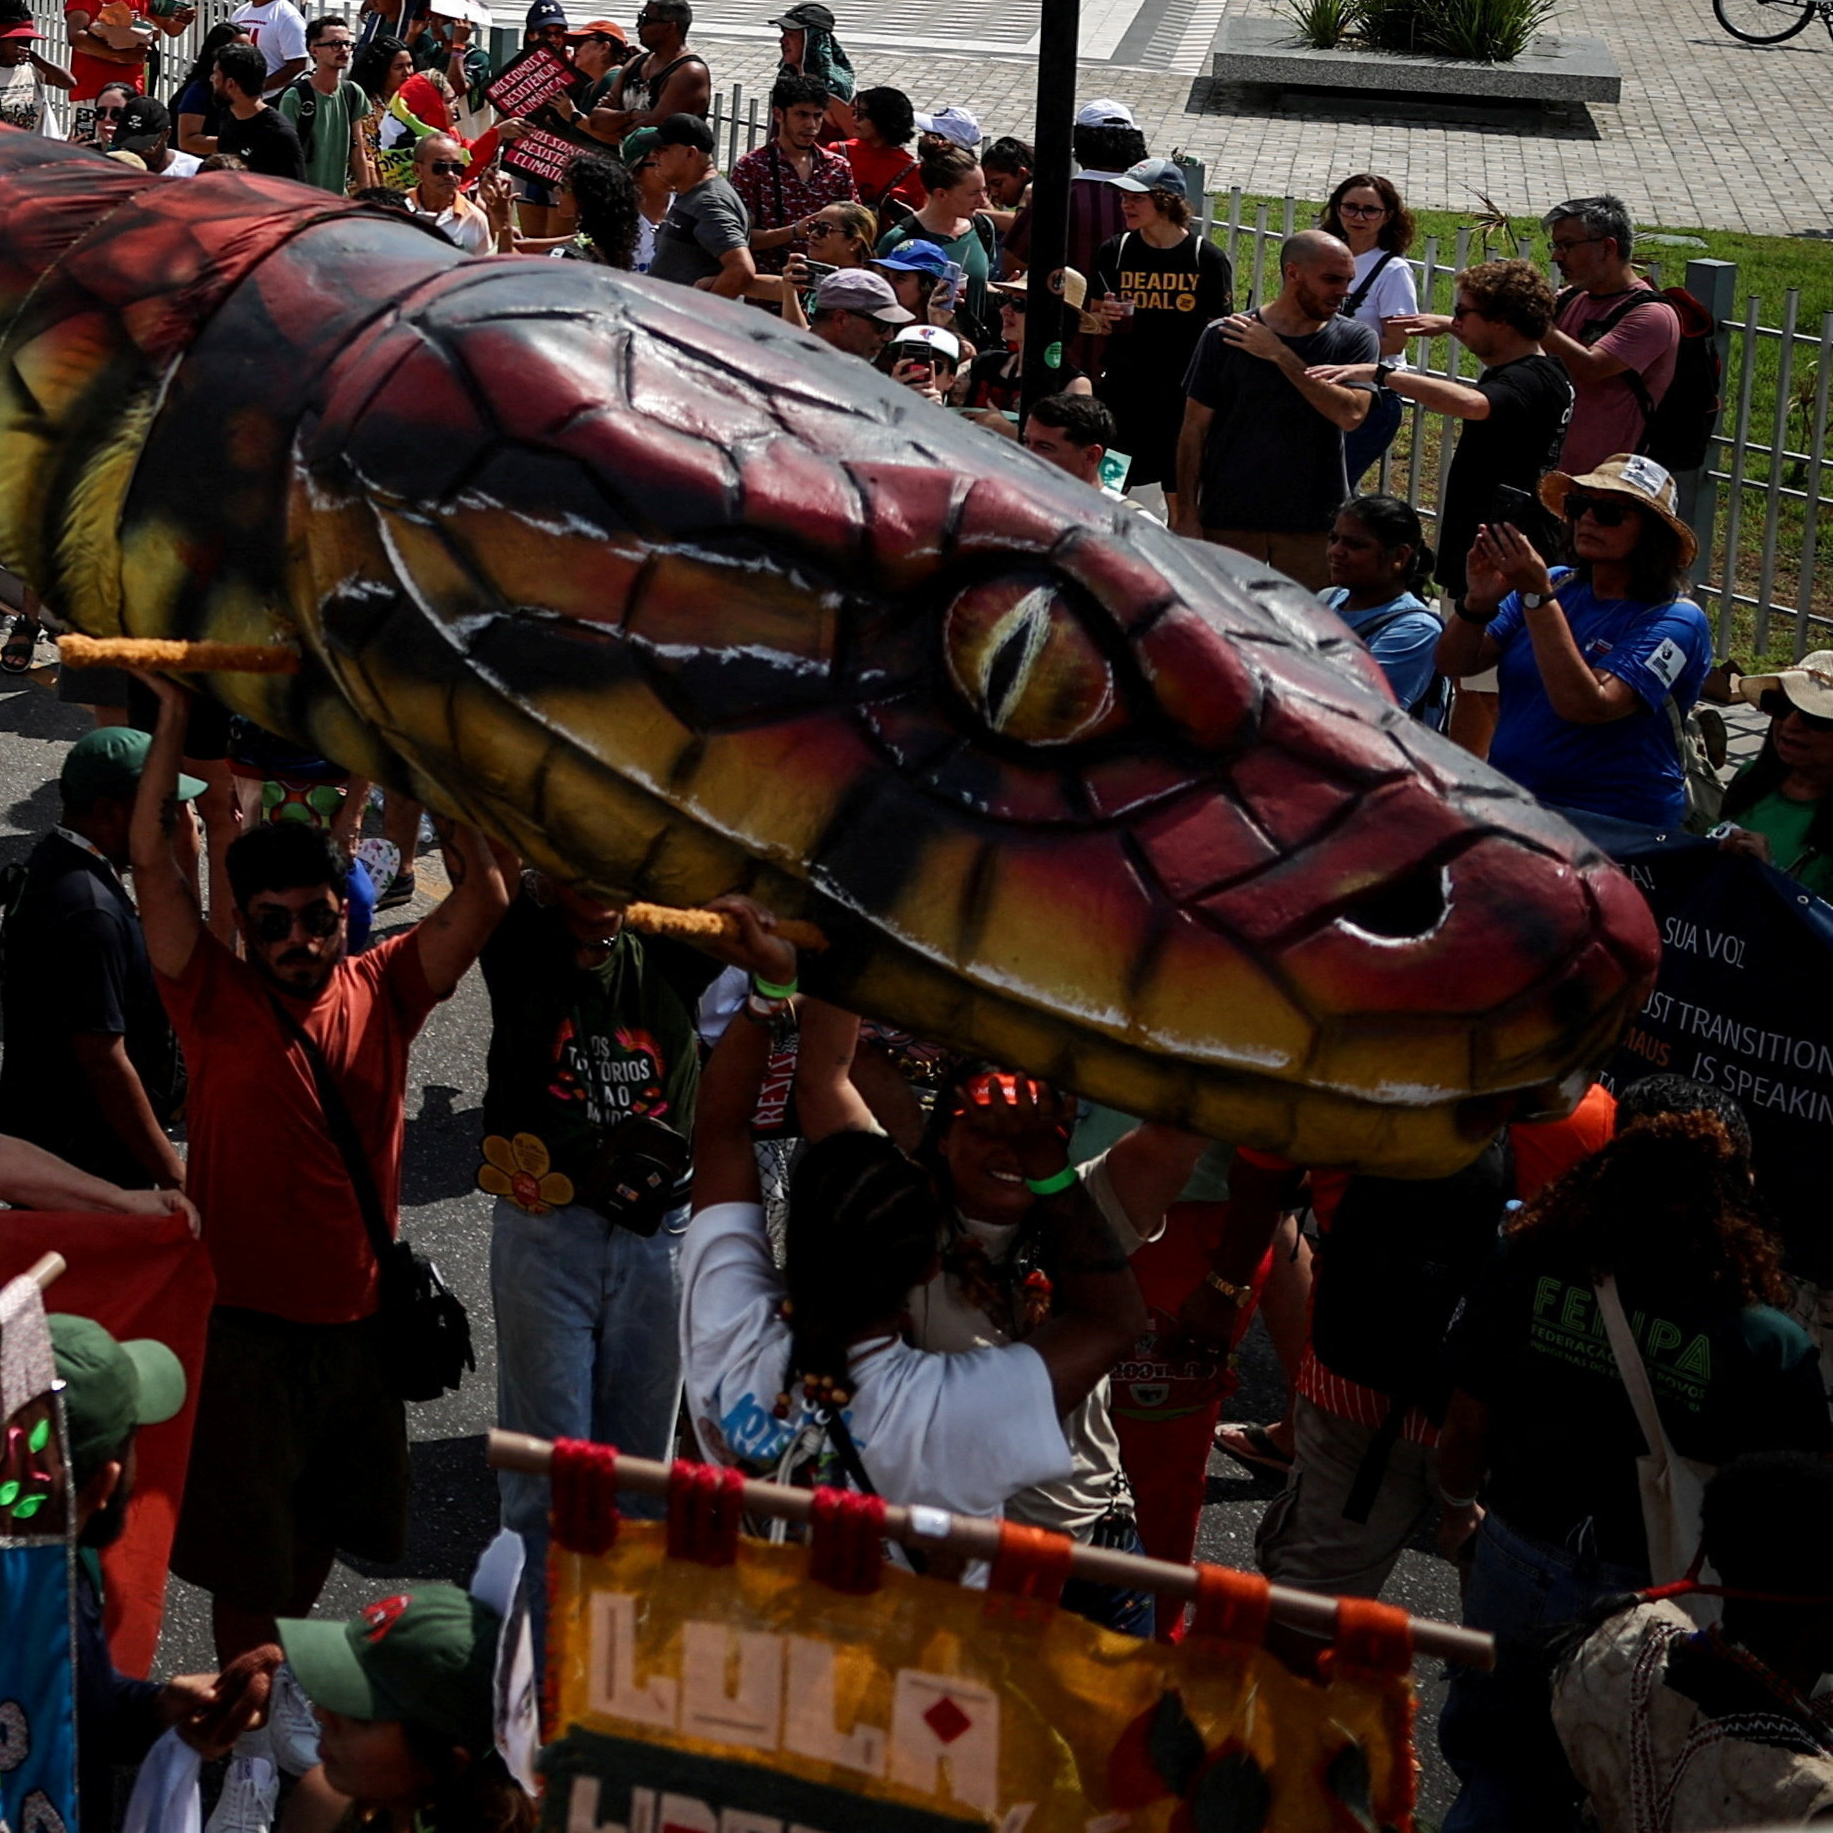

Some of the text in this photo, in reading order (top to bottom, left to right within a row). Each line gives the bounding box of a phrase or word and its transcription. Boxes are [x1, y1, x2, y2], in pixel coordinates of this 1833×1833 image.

[1120, 270, 1202, 292] DEADLY
[1663, 915, 1748, 971] SUA VOZ
[1678, 998, 1833, 1074] TRANSITION
[1692, 1056, 1833, 1127] IS SPEAKIN
[586, 1591, 1002, 1812] LULA
